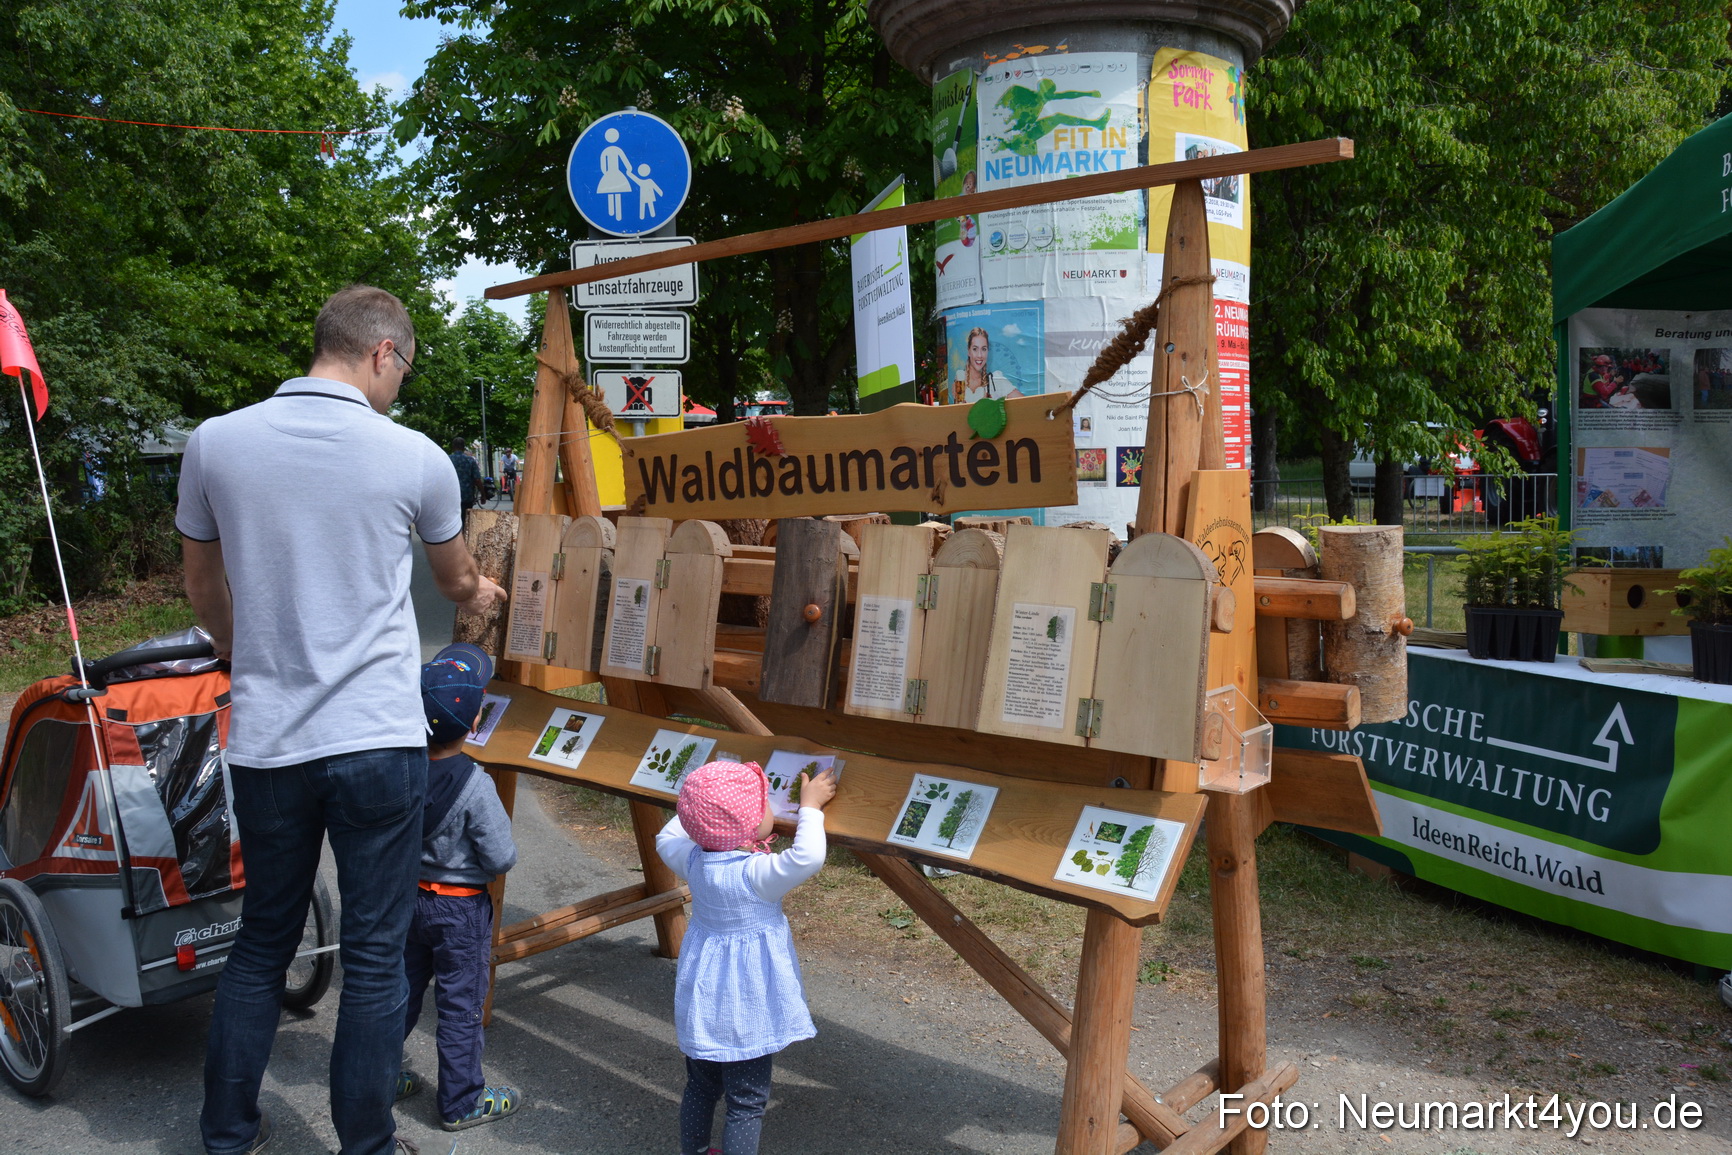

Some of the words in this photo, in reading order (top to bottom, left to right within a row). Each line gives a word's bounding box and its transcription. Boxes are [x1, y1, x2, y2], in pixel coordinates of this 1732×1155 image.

[1168, 58, 1214, 84] Sommer
[1173, 81, 1213, 111] Park
[1053, 127, 1093, 150] FIT
[1101, 127, 1127, 148] IN
[985, 150, 1127, 181] NEUMARKT
[1063, 270, 1117, 279] NEUMARKT
[588, 278, 683, 296] Einsatzfahrzeuge
[594, 319, 643, 330] Widerrechtlich
[644, 320, 681, 331] abgestellte
[1655, 328, 1712, 341] Beratung
[599, 343, 648, 354] kostenpflichtig
[649, 343, 676, 353] entfernt
[607, 332, 641, 342] Fahrzeuge
[642, 332, 668, 341] werden
[638, 431, 1041, 505] Waldbaumarten
[1312, 727, 1612, 823] FORSTVERWALTUNG
[1412, 816, 1605, 895] IdeenReich.Wald
